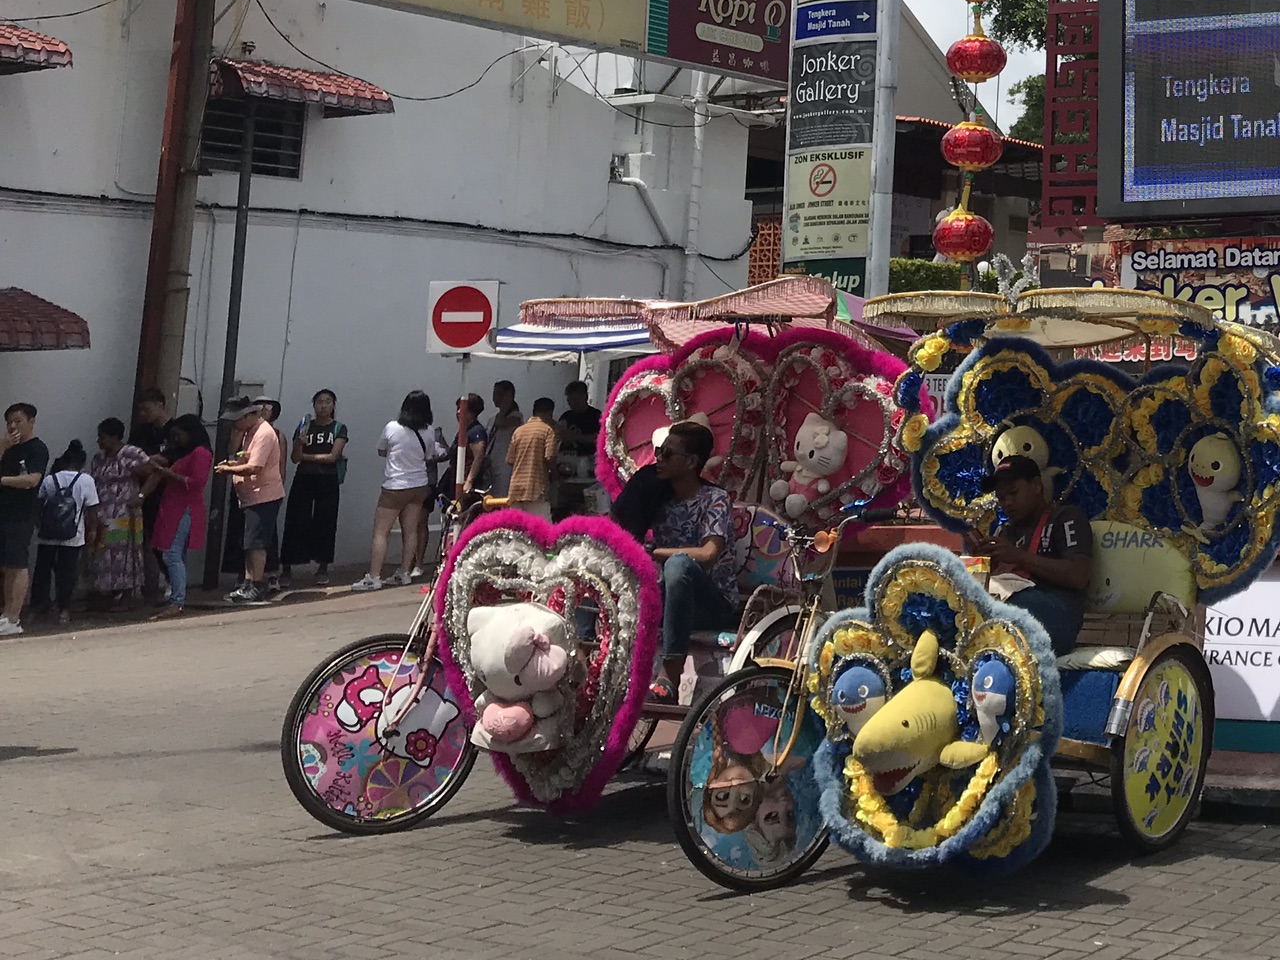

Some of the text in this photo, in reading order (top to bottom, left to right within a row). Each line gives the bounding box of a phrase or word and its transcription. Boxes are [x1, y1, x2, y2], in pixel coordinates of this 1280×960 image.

[807, 9, 836, 20] Tengkera
[807, 18, 850, 31] Masjid Tanah
[800, 50, 860, 77] Jonker
[796, 80, 860, 104] Gallery
[1161, 73, 1251, 102] Tengkera
[1161, 115, 1224, 146] Masjid
[794, 151, 865, 164] ZON EKSKLUSIF
[1133, 249, 1217, 271] Selamat
[1064, 520, 1077, 547] E
[1205, 616, 1244, 637] KIO
[754, 701, 795, 721] ROZEN
[327, 729, 355, 767] Hello
[1145, 688, 1188, 802] SHARK
